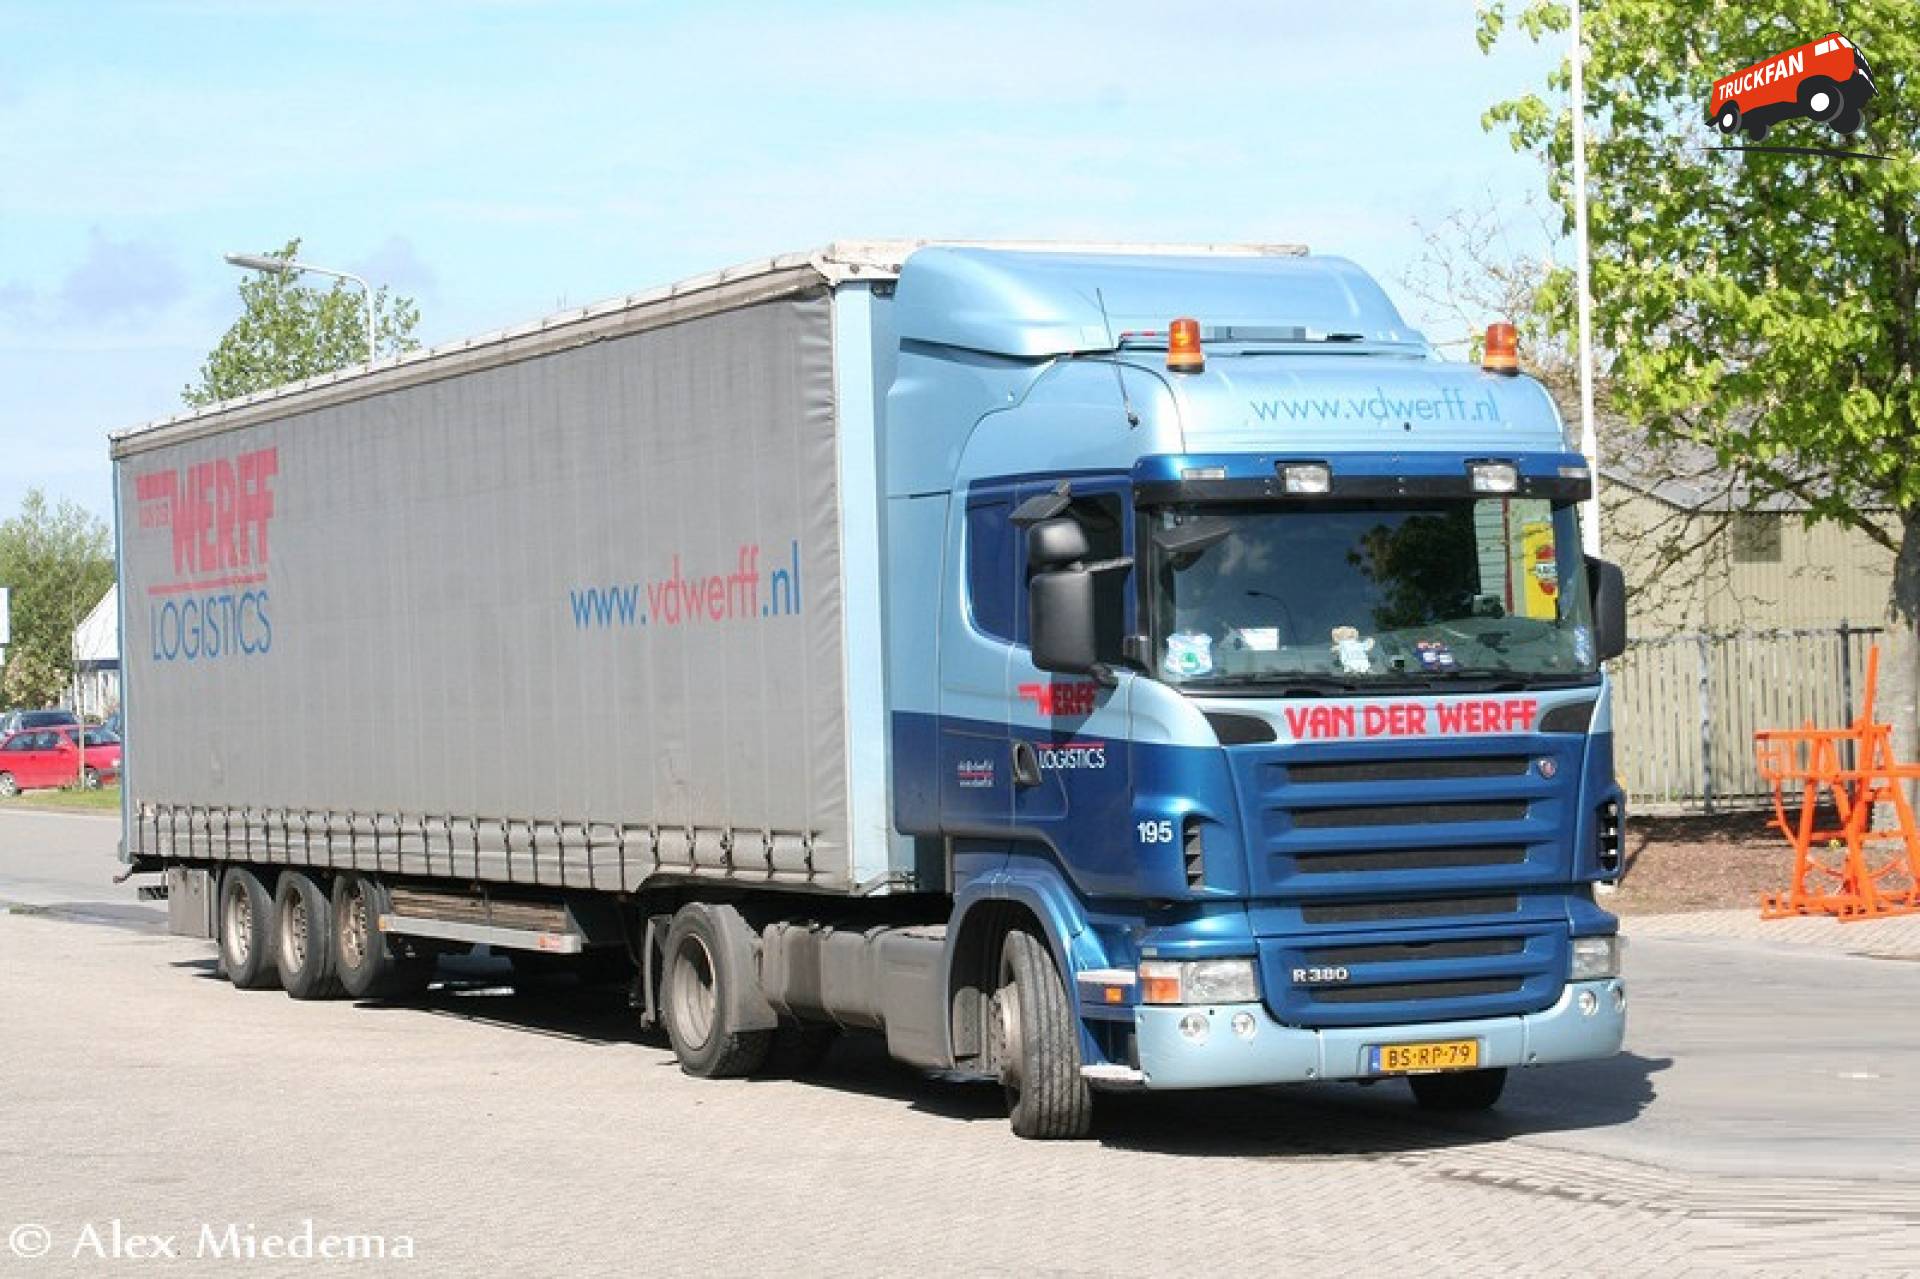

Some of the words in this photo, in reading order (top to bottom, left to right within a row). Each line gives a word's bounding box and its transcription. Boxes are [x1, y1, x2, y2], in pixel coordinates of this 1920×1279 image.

[1249, 387, 1500, 421] www.vdwerff.nl
[137, 446, 279, 577] WERFF
[569, 540, 801, 630] www.vdwerff.nl
[149, 590, 272, 661] LOGISTICS
[1018, 682, 1097, 716] WERFF
[1285, 704, 1355, 739] VAN
[1363, 703, 1427, 736] DER
[1436, 698, 1537, 734] WERFF
[1038, 748, 1105, 769] LOGISTICS
[1136, 820, 1174, 844] 195
[1387, 1044, 1471, 1068] BS-RP-79
